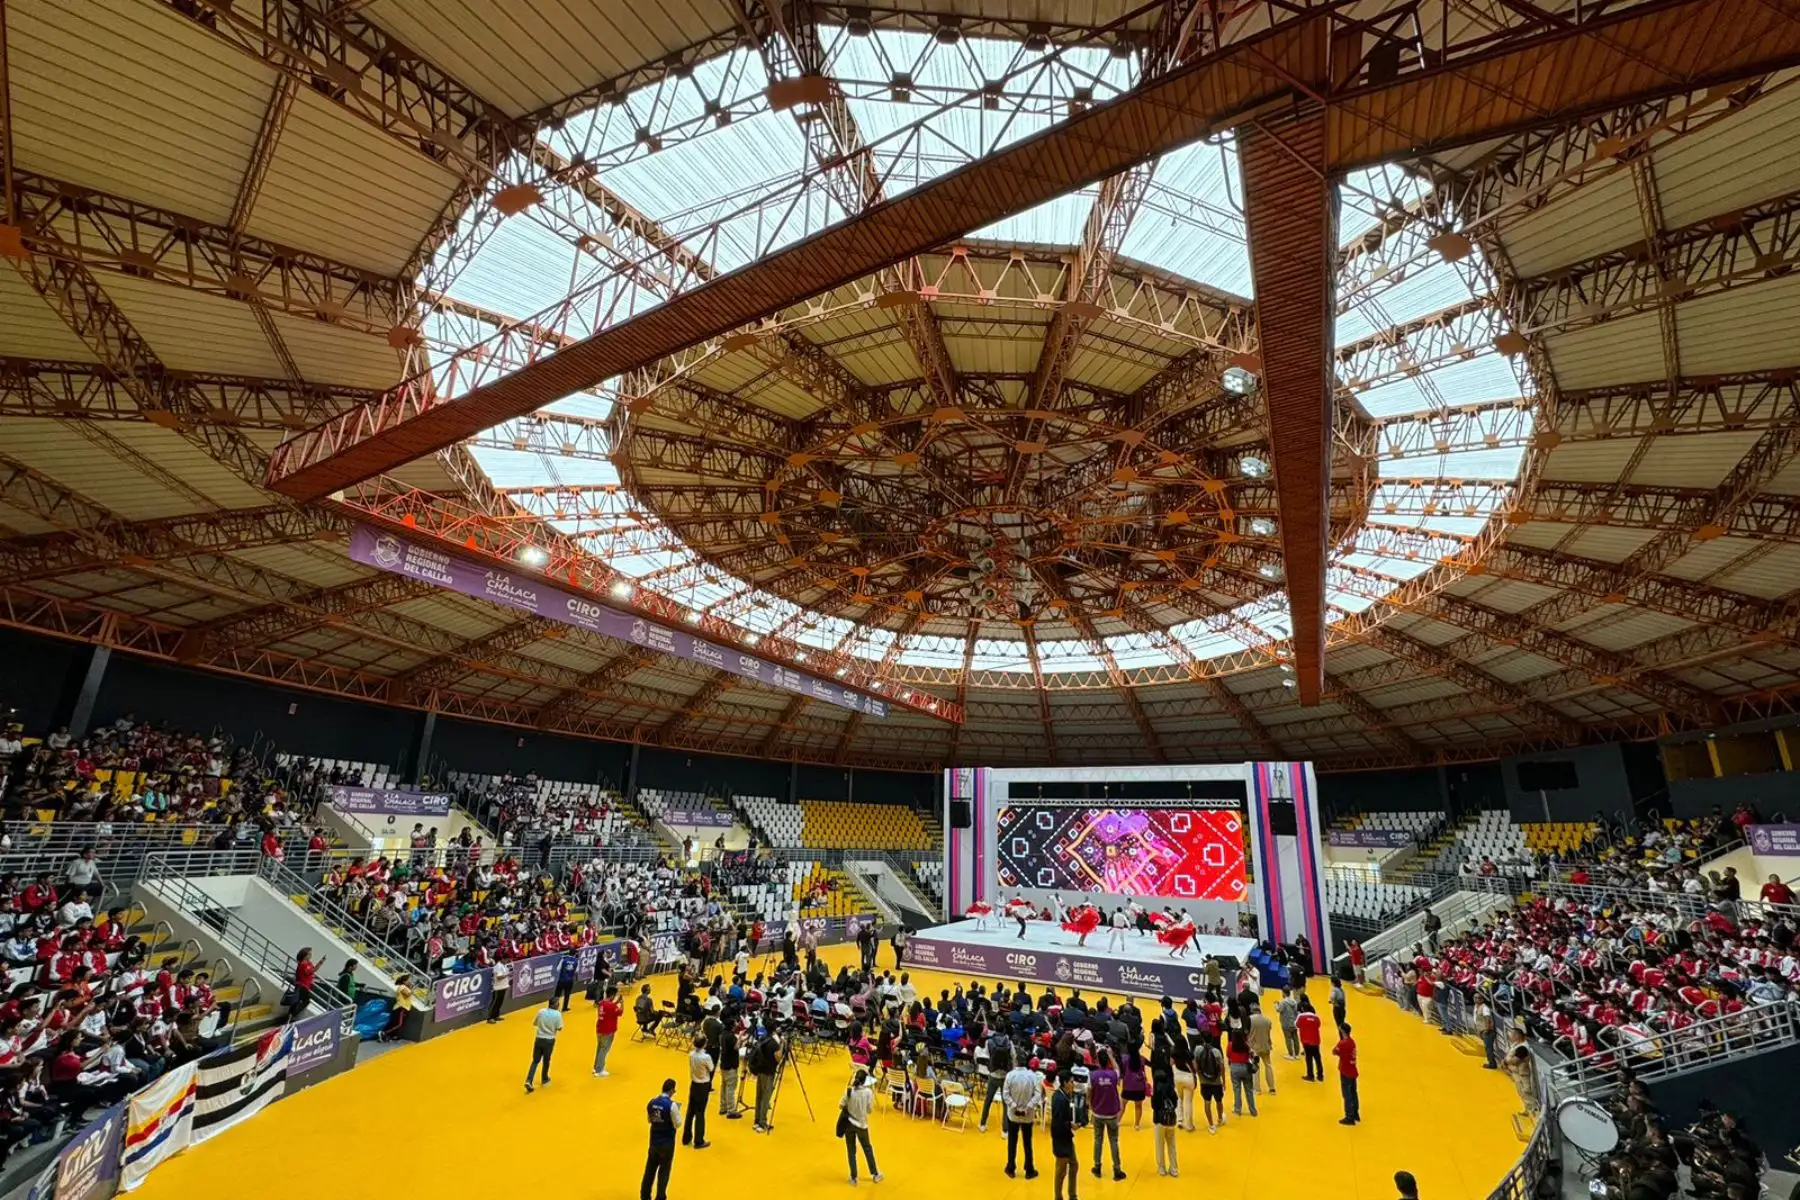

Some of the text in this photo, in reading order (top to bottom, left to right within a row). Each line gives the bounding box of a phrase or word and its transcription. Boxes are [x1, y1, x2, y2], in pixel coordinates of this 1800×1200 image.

[408, 545, 450, 565] GOBIERNO
[406, 554, 447, 574] REGIONAL
[404, 563, 453, 584] DEL CALLAO
[484, 571, 510, 585] A LA
[487, 580, 537, 602] CHALACA
[567, 599, 600, 618] CIRO
[739, 656, 760, 670] CIRO
[422, 796, 449, 805] CIRO
[1389, 832, 1410, 840] CIRO
[804, 919, 827, 930] CIRO
[953, 953, 985, 962] CHALACA
[1006, 953, 1037, 966] CIRO
[1121, 972, 1161, 983] CHALACA
[443, 973, 482, 999] CIRO
[1584, 1108, 1608, 1124] YAMAHA
[60, 1118, 112, 1189] CIRO
